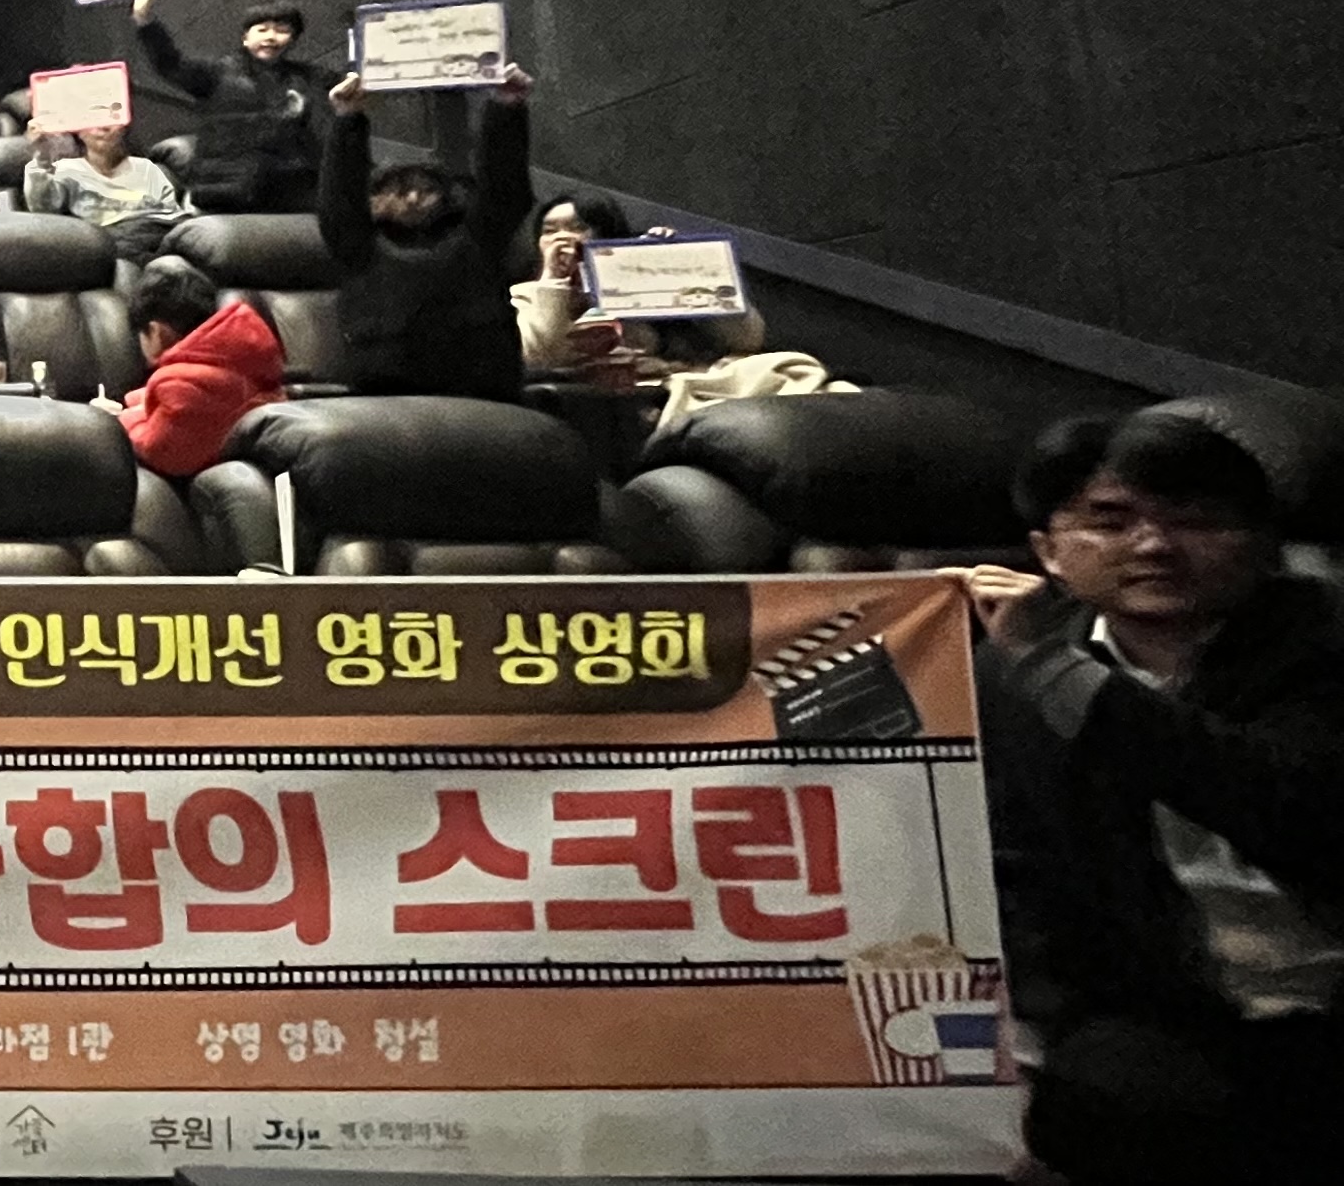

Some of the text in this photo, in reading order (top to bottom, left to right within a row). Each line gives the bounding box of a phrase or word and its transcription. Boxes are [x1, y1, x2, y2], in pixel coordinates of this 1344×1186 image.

[317, 610, 463, 687] 영화
[493, 610, 711, 686] 상영회
[393, 783, 850, 943] 스크린
[196, 1021, 262, 1063] 상영
[278, 1018, 346, 1063] 영화
[149, 1116, 214, 1152] 후원
[263, 1118, 322, 1150] Jeju
